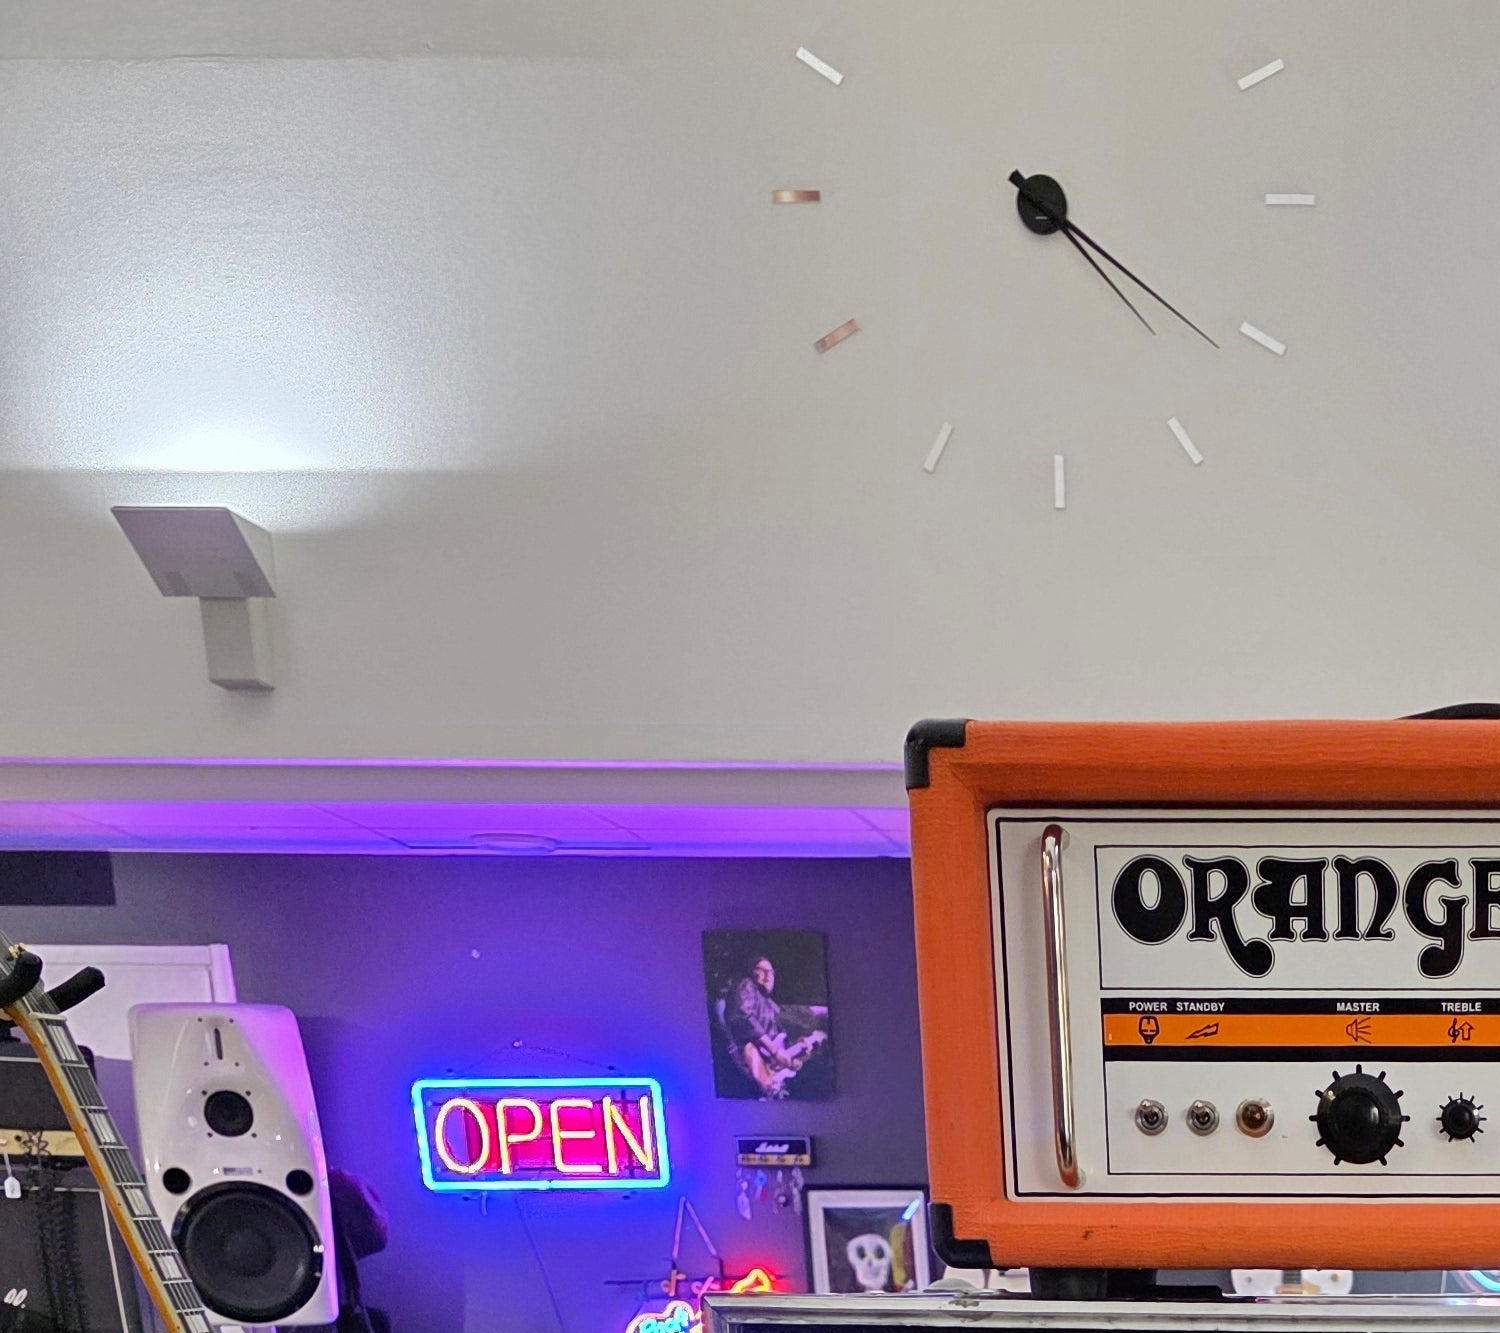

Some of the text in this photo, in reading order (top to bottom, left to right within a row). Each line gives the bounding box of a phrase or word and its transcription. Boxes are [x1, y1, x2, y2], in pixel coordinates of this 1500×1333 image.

[1128, 1002, 1168, 1012] POWER
[1176, 1002, 1225, 1012] STANDBY
[1336, 1002, 1380, 1012] MASTER
[1441, 1002, 1482, 1012] TREBLE
[434, 1095, 654, 1176] OPEN
